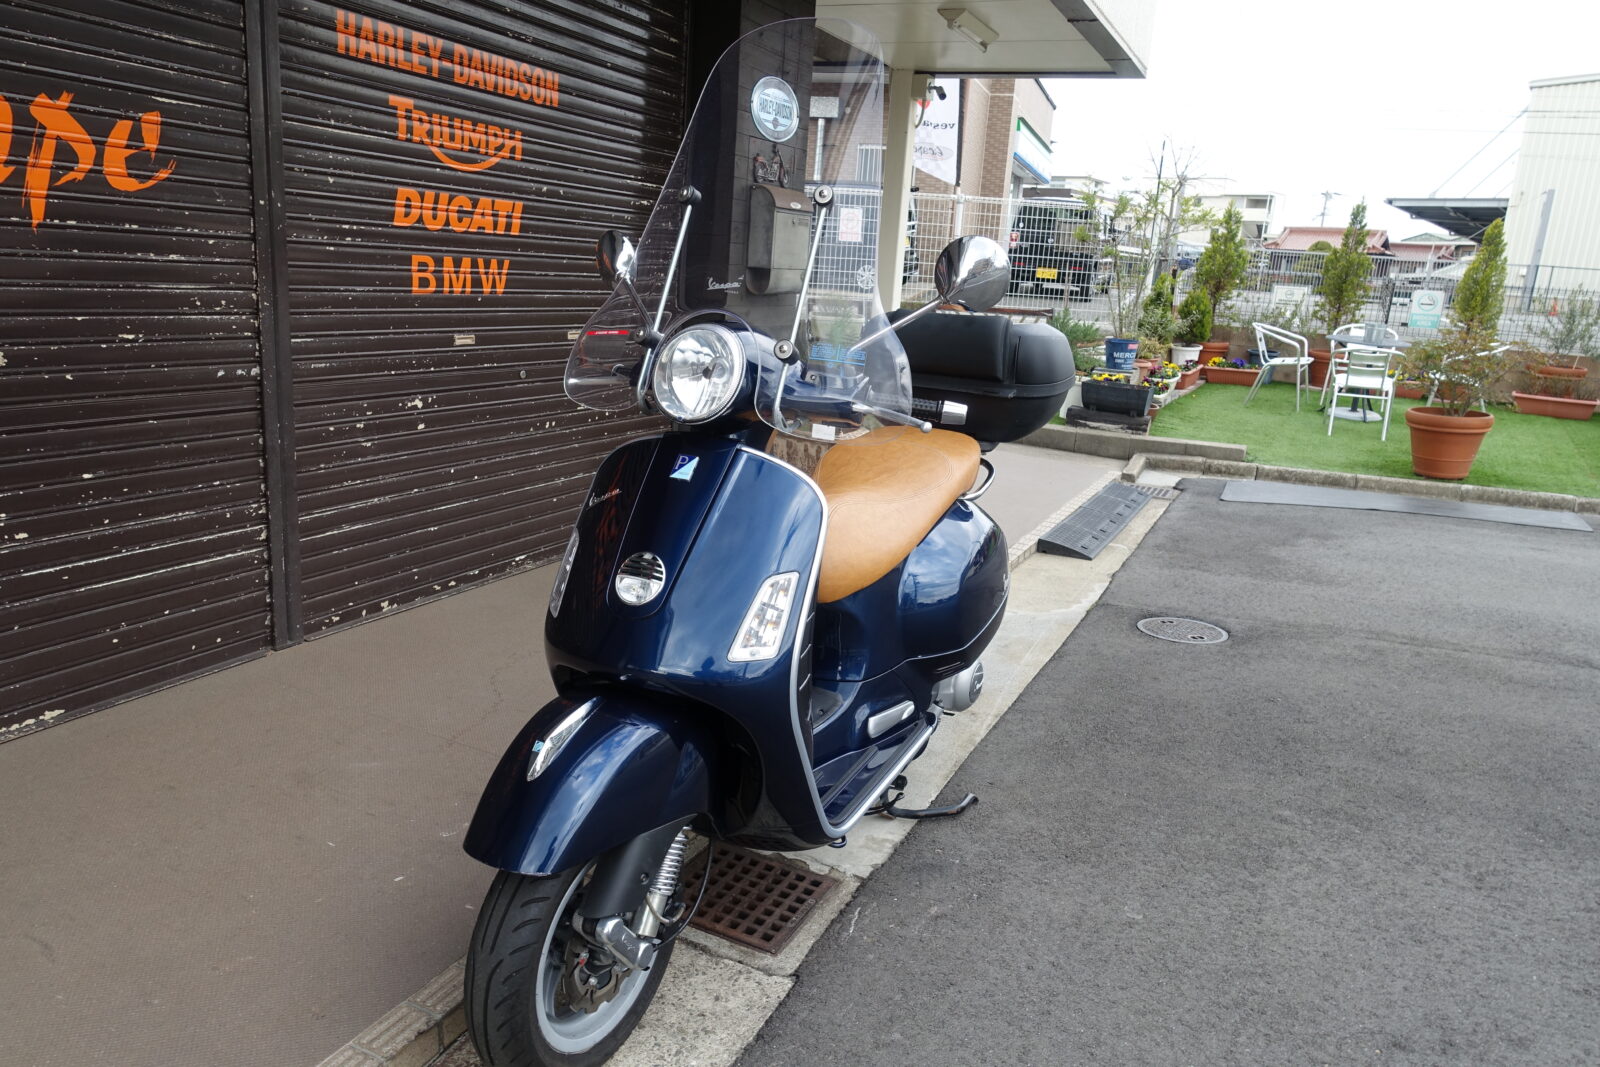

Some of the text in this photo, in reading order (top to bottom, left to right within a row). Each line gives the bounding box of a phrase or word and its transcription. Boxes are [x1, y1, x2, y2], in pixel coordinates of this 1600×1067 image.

[336, 9, 559, 107] HARLEY-DAVIDSON
[393, 187, 524, 236] DUCATI
[410, 254, 510, 296] BMW
[705, 276, 742, 291] Vespa
